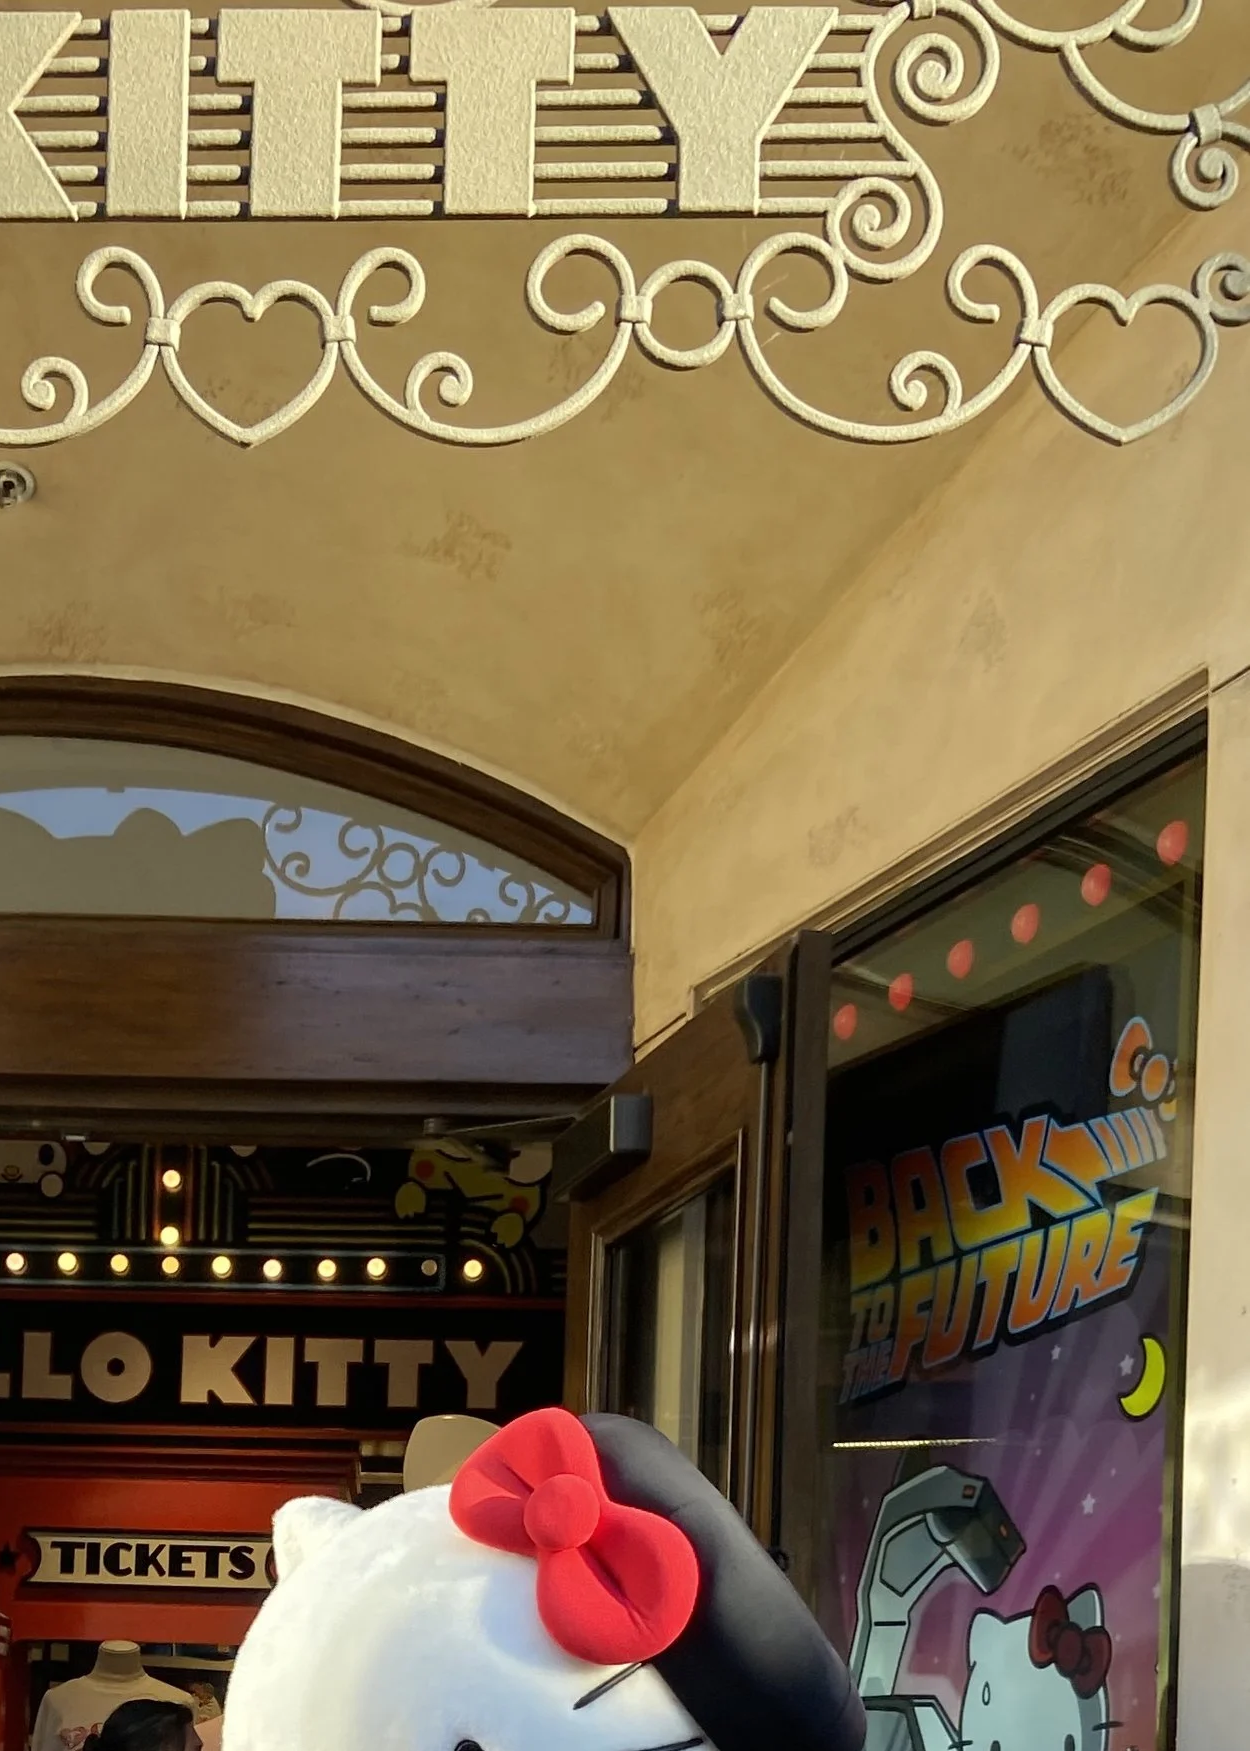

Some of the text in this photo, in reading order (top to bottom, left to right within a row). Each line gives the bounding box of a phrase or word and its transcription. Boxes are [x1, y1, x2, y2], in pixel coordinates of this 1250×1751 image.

[843, 1114, 1105, 1290] BACK
[850, 1284, 894, 1353] TO
[888, 1188, 1158, 1384] FUTURE
[180, 1335, 523, 1410] KITTY
[839, 1338, 895, 1405] THE
[50, 1541, 256, 1581] TICKETS
